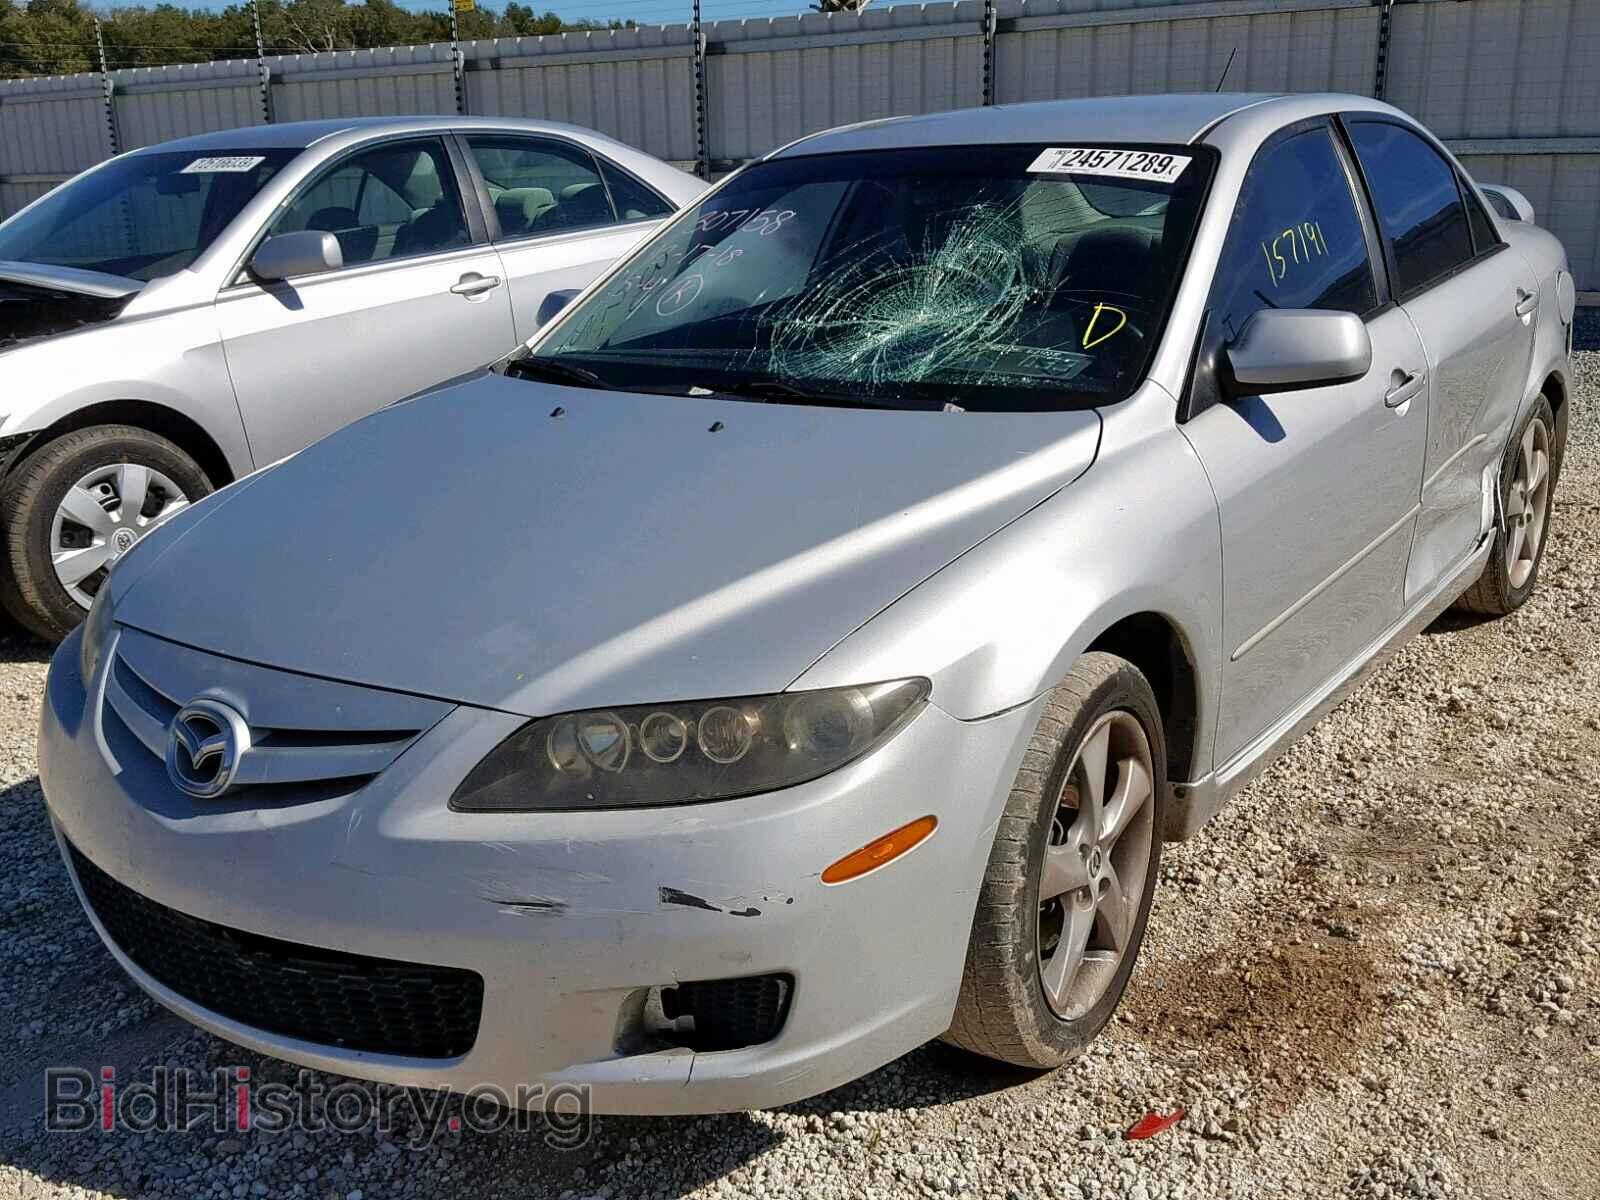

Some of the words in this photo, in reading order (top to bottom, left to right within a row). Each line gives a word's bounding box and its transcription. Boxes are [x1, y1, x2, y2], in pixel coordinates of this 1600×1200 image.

[1062, 150, 1174, 175] 24571289
[1262, 221, 1329, 288] 157191
[1082, 302, 1126, 349] D
